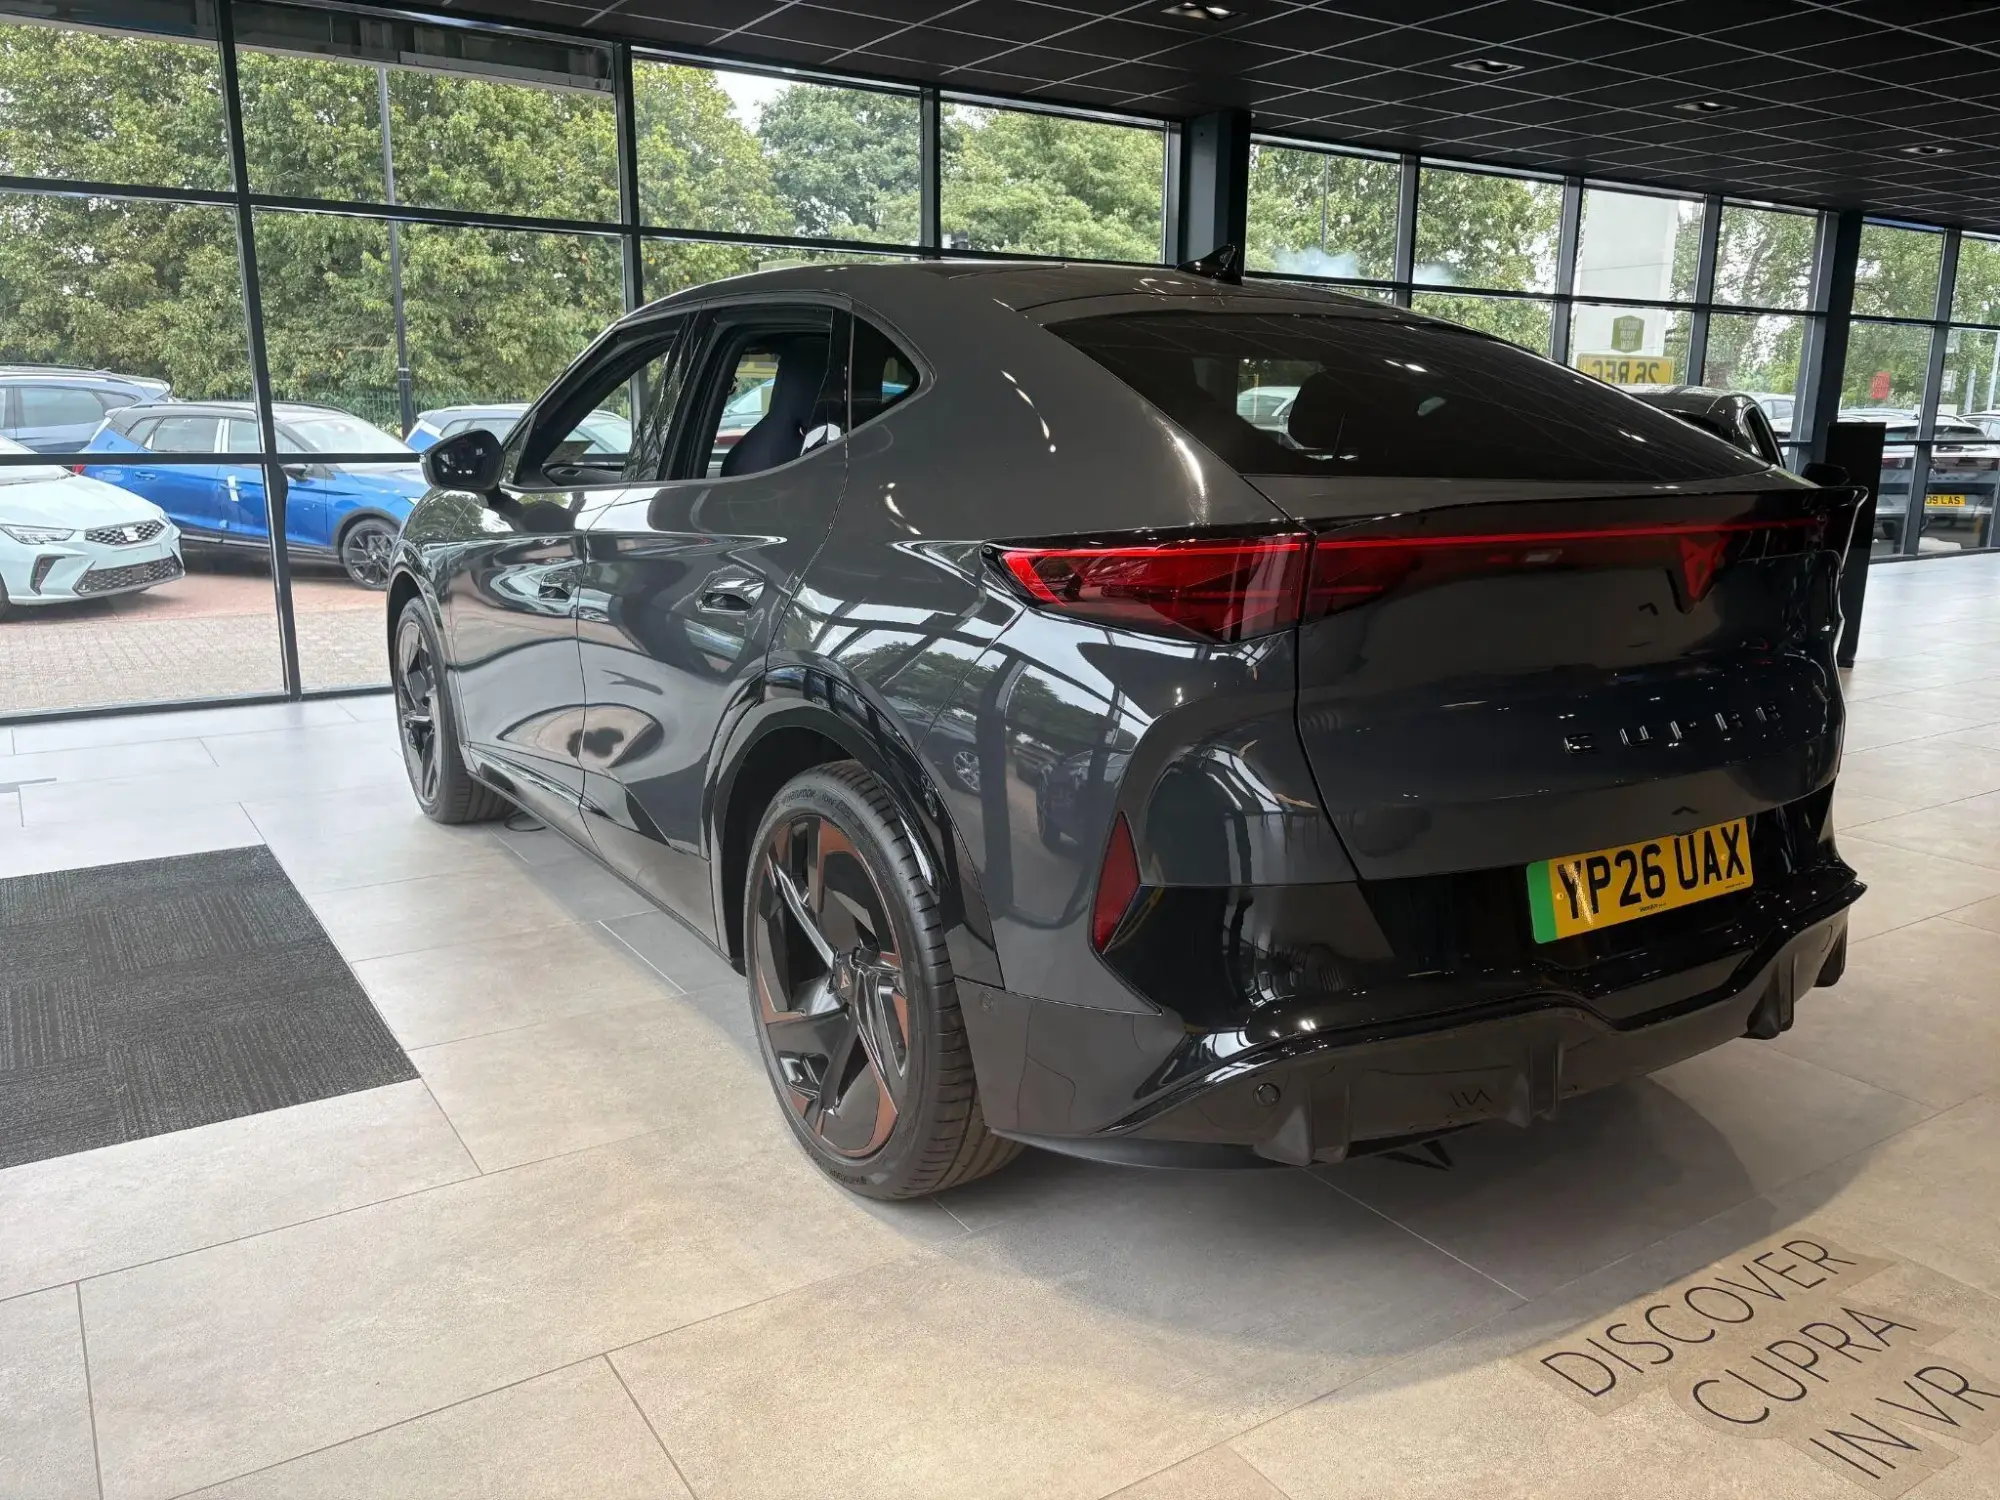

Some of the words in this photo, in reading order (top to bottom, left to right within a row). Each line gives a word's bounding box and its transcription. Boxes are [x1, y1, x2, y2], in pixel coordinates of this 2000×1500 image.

[1941, 496, 1960, 504] LAS
[1557, 844, 1666, 920] YP26
[1675, 823, 1745, 890] UAX
[1540, 1239, 1857, 1397] DISCOVER
[1692, 1307, 1918, 1425] CUPRA
[1809, 1413, 1922, 1480] IN
[1875, 1366, 2000, 1428] VR
